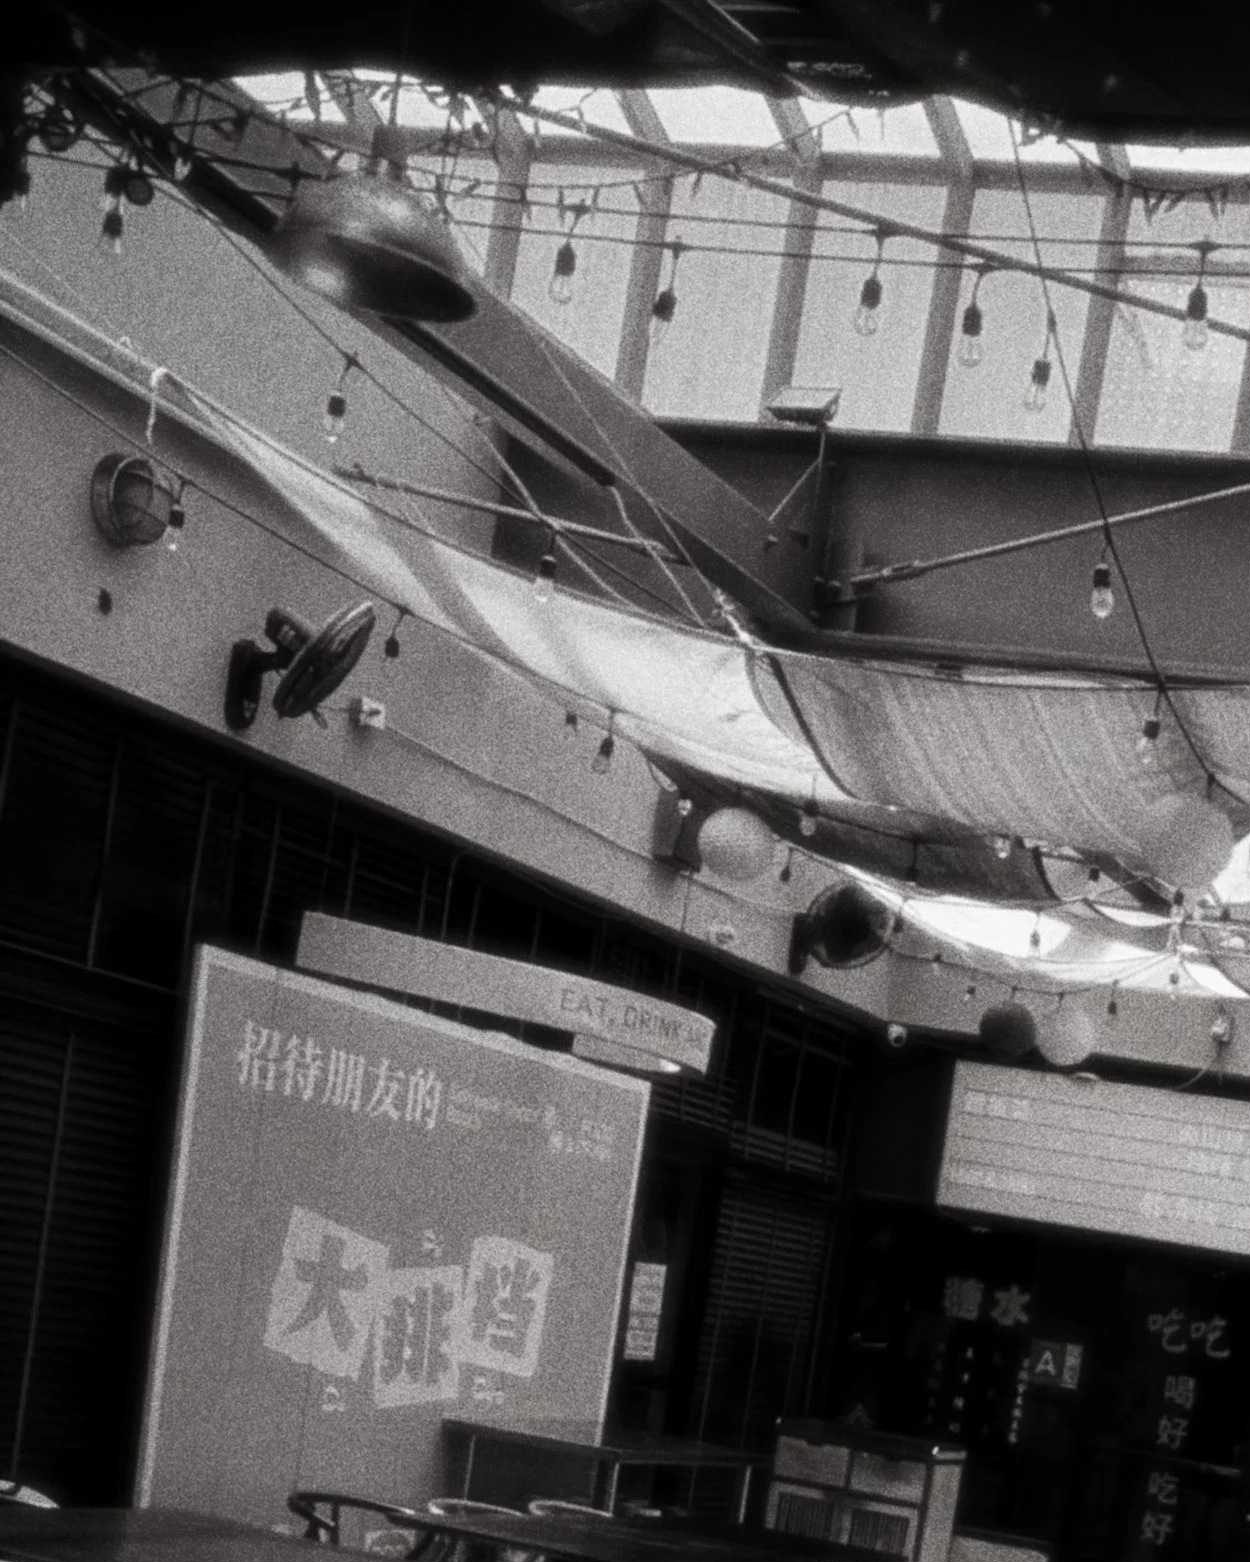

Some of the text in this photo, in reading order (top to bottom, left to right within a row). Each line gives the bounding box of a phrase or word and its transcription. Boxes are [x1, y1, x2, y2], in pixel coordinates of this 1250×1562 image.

[237, 1019, 443, 1130] 招待朋友的
[1147, 1307, 1232, 1360] 吃吃
[1033, 1350, 1057, 1377] A
